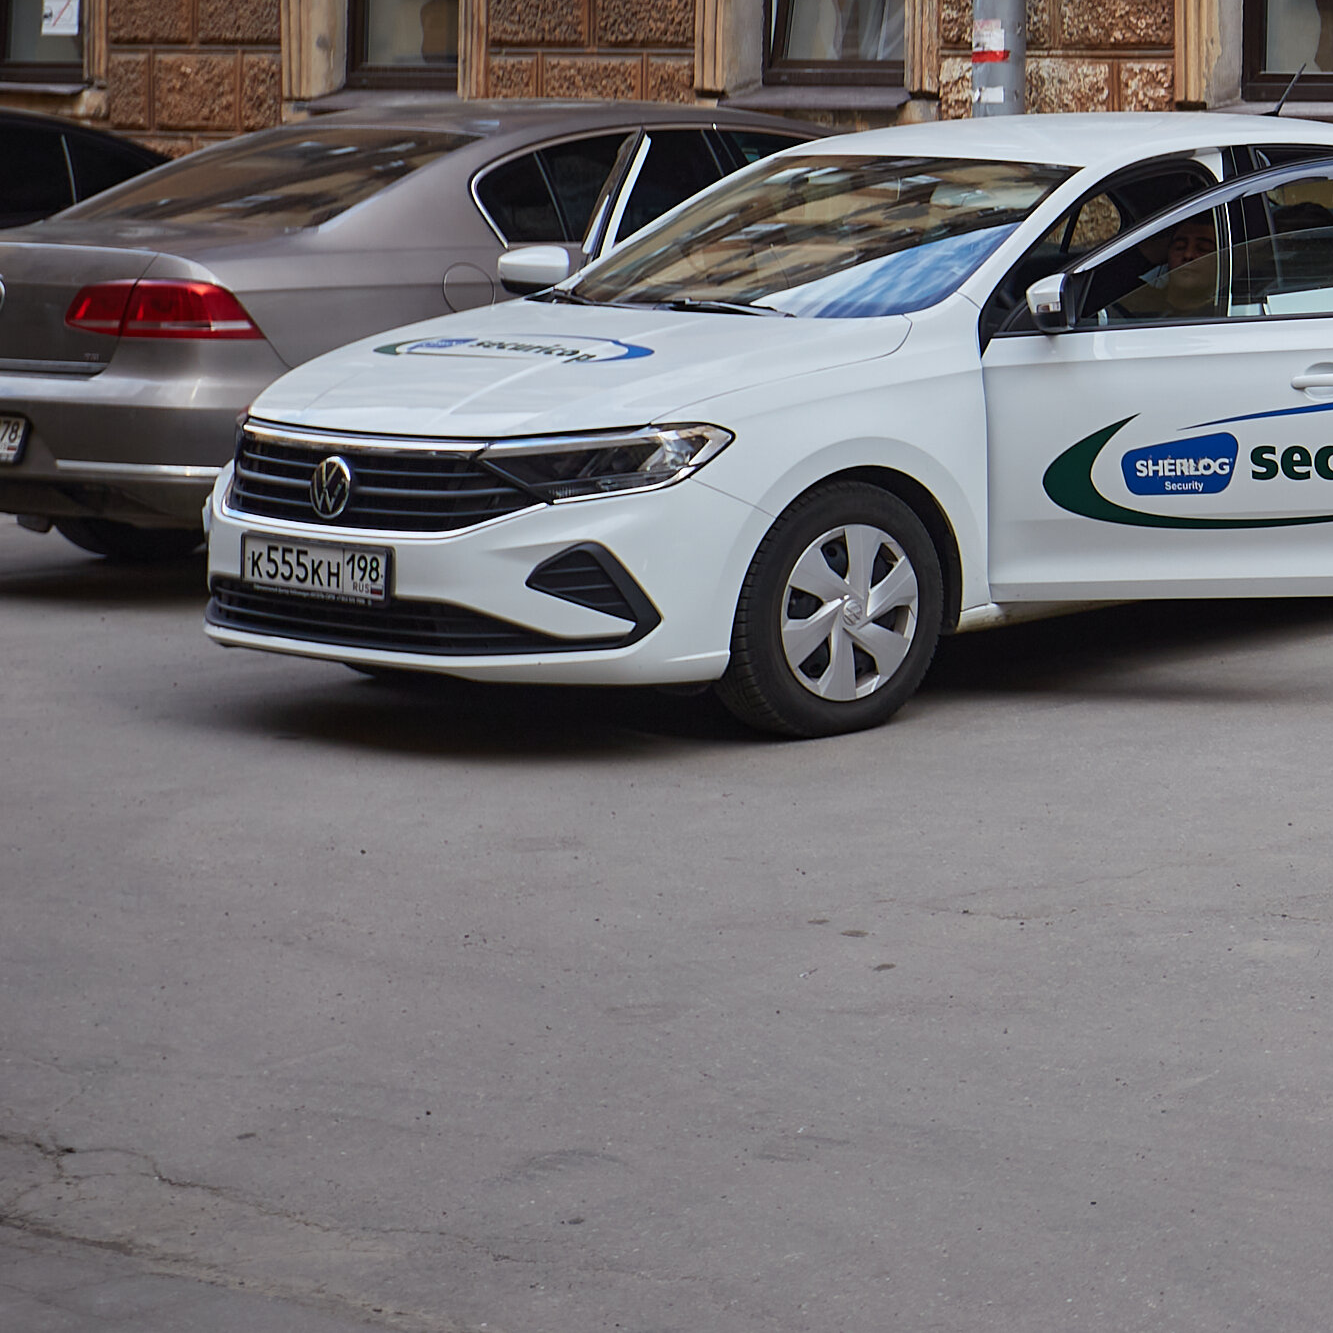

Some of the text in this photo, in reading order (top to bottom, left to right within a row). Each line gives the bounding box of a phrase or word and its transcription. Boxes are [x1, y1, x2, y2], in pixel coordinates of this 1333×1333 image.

[0, 420, 20, 443] 78
[1135, 458, 1231, 478] SHERLOG
[1164, 481, 1204, 493] Security
[346, 553, 380, 583] 198
[353, 581, 370, 594] RUS
